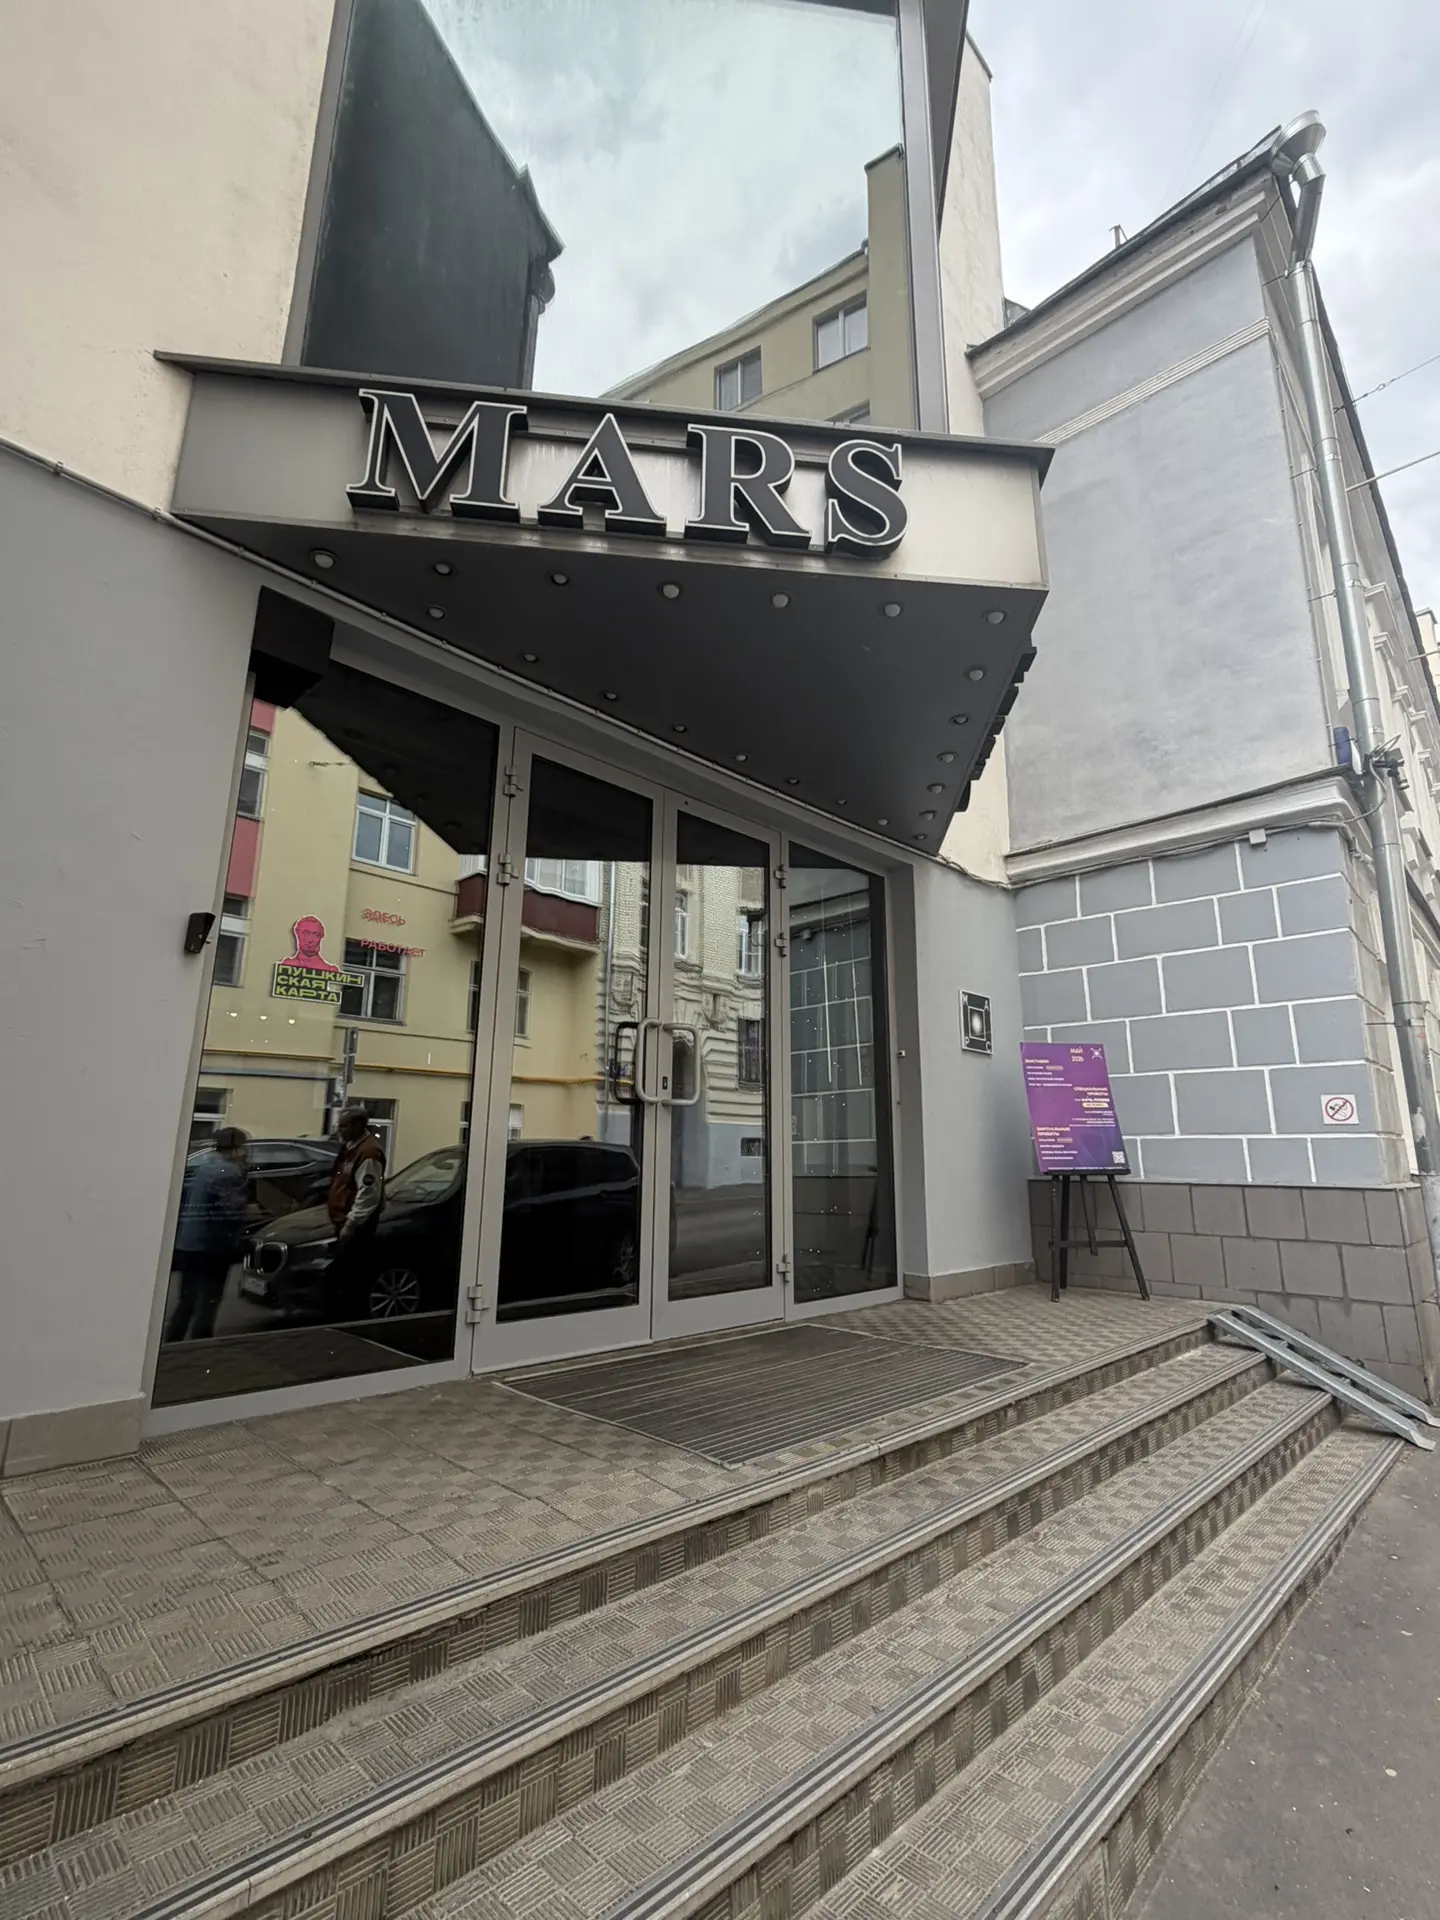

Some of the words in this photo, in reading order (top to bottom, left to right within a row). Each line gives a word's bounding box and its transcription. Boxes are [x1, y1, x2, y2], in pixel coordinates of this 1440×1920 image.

[346, 388, 909, 550] MARS
[361, 907, 407, 926] ЗДЕСЬ
[359, 937, 426, 959] РАБОТАЕТ
[277, 965, 362, 985] ПУШКИН
[277, 976, 326, 990] СКАЯ
[275, 985, 339, 1002] КАРТА
[1070, 1047, 1083, 1055] МАЙ
